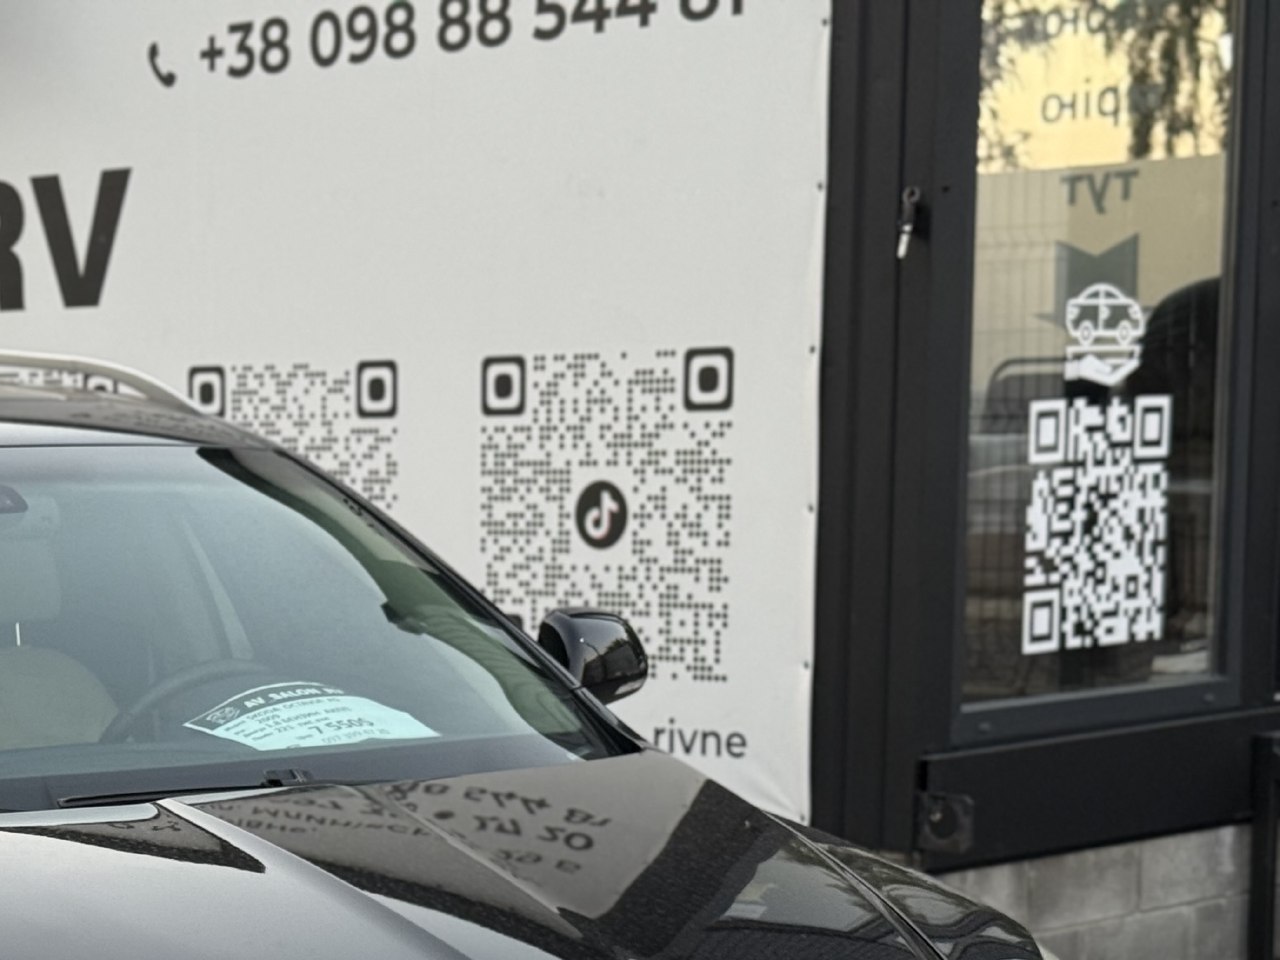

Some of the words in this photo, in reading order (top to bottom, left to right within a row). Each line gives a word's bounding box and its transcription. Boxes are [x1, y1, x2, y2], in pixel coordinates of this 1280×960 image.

[200, 17, 290, 79] +38
[309, 0, 417, 67] 098
[437, 0, 513, 52] 88
